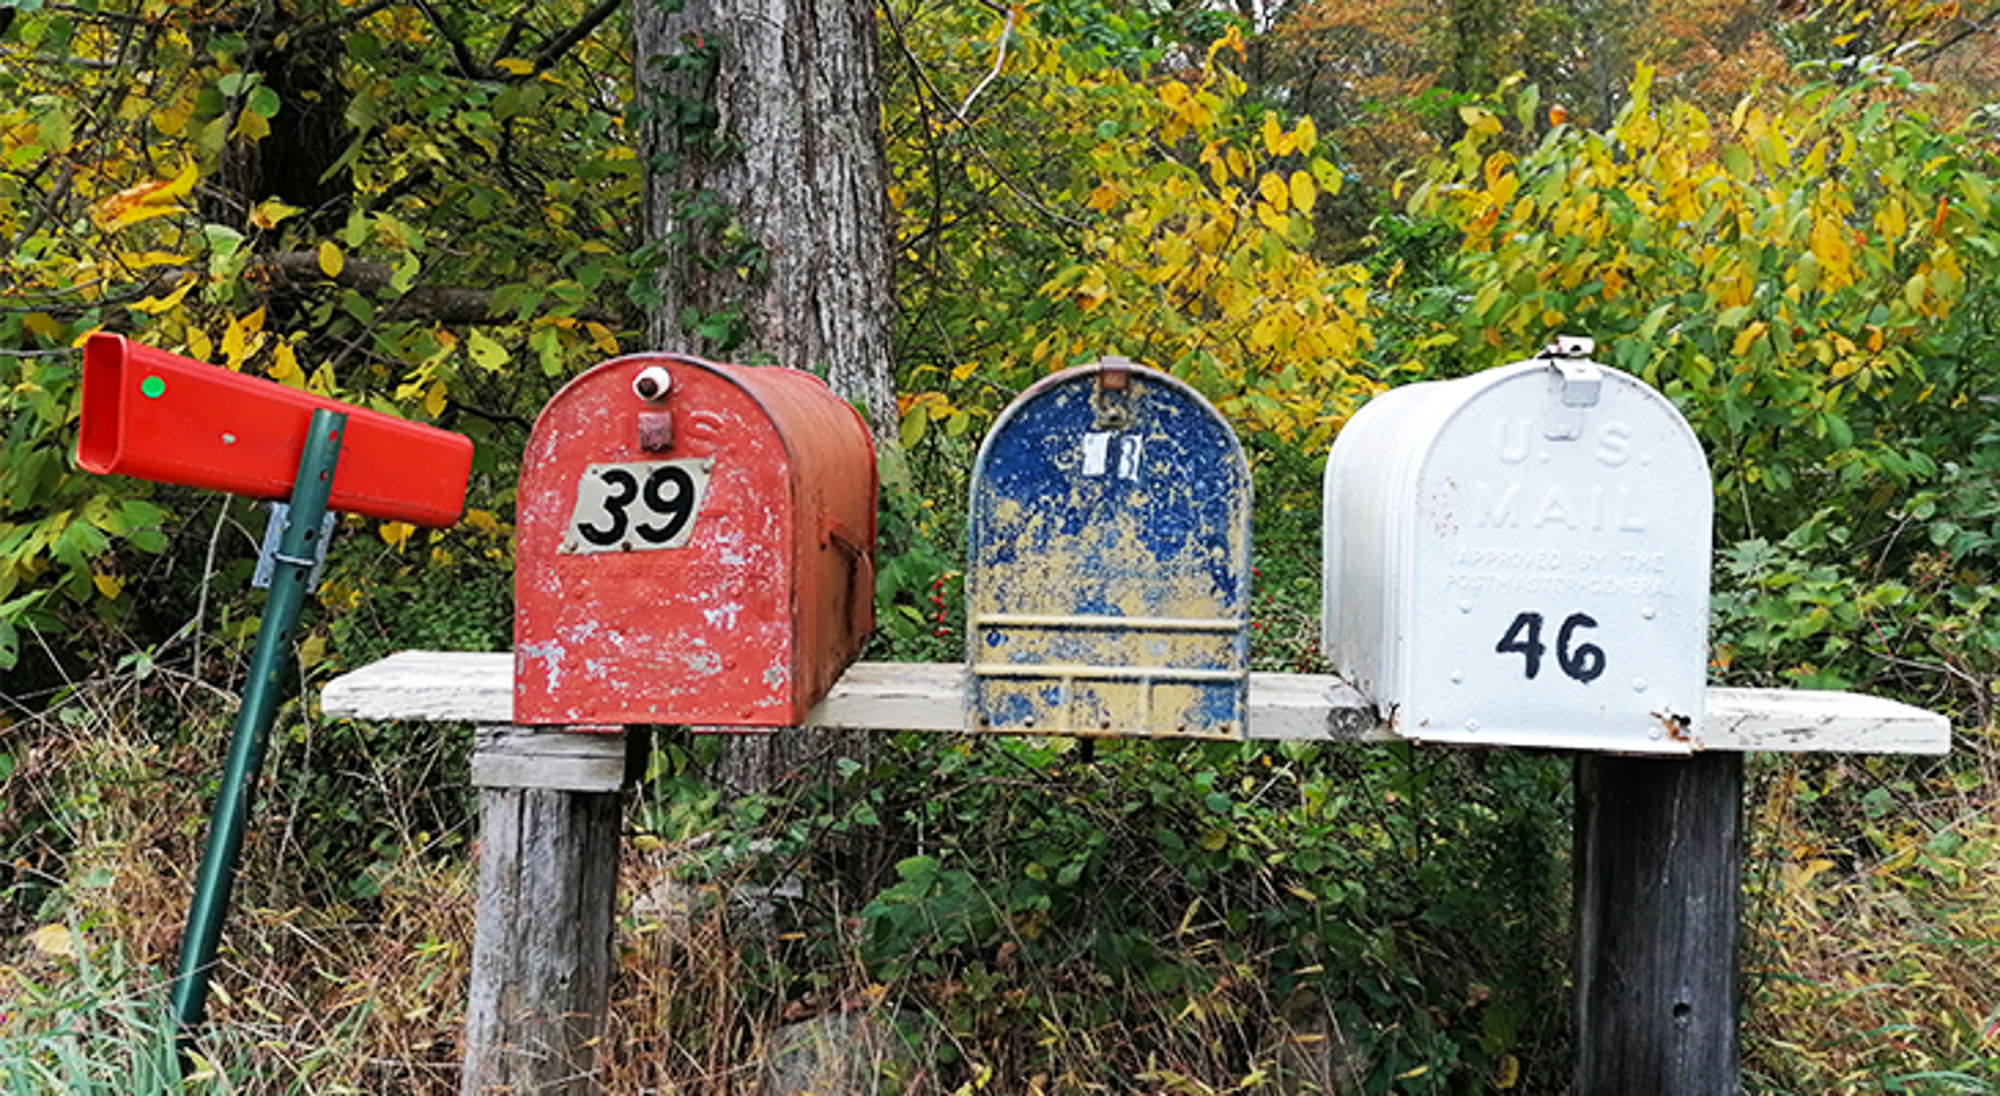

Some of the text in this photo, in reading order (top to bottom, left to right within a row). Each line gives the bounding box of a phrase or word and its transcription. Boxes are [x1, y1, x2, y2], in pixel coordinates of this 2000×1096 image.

[577, 466, 695, 546] 39
[1475, 481, 1647, 533] MAIL
[1495, 612, 1607, 684] 46
